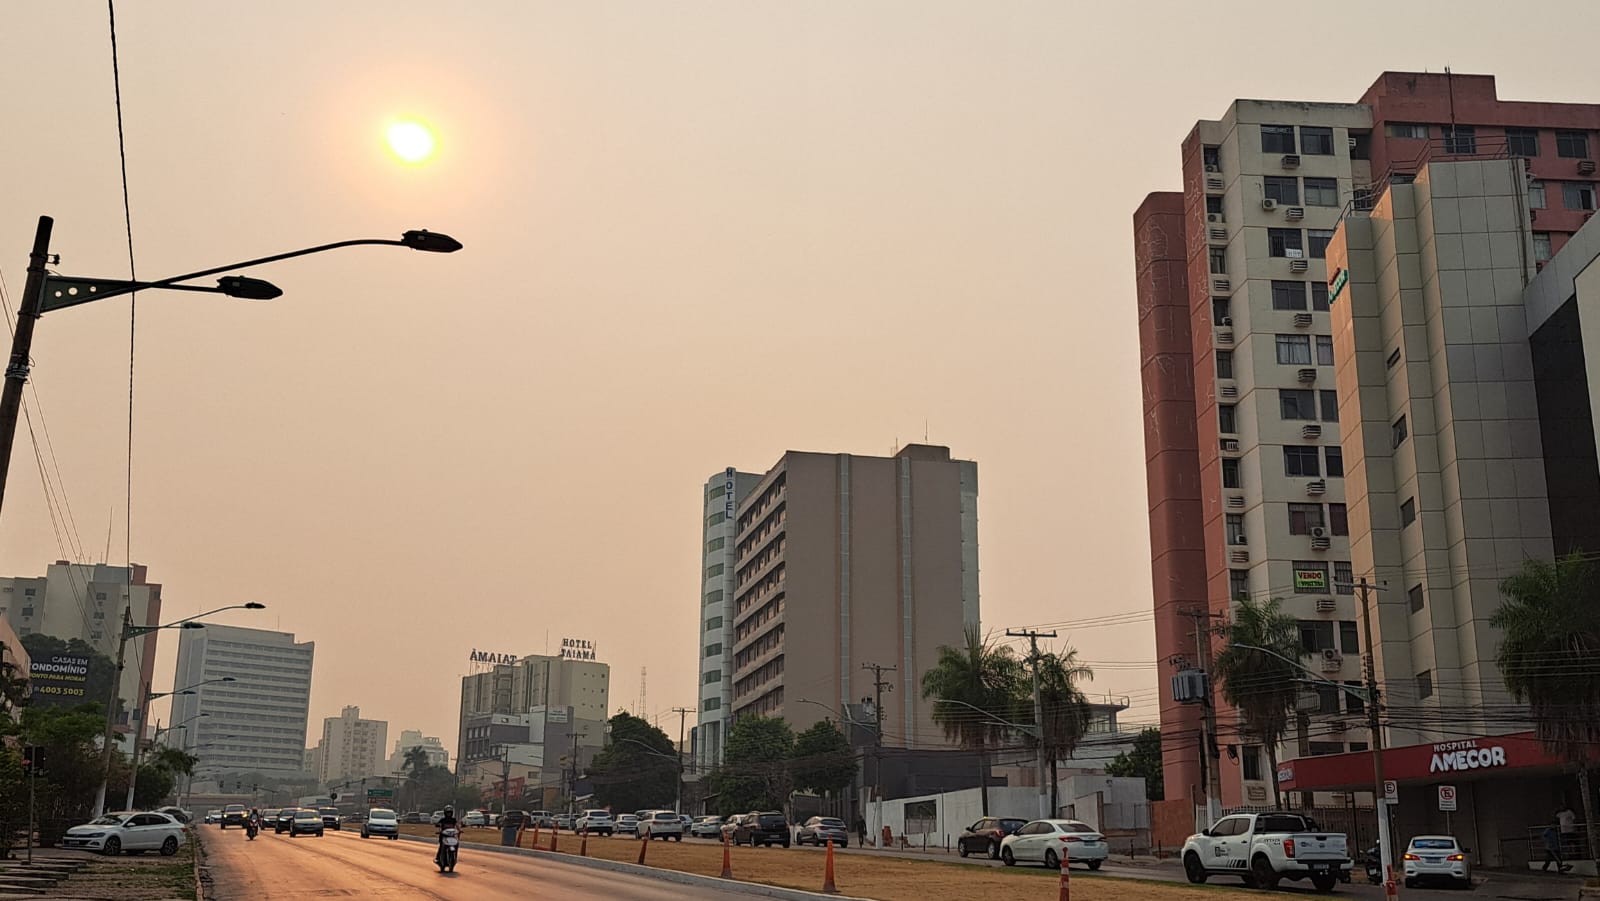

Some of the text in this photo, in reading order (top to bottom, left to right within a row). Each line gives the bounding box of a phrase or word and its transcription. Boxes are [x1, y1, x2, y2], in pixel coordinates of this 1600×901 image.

[725, 467, 734, 520] HOTEL
[562, 638, 592, 649] HOTEL
[51, 656, 88, 666] CASAS EM
[31, 662, 87, 674] ONDOMÍNIO
[40, 686, 84, 696] 4003 5003
[1433, 740, 1478, 752] HOSPITAL
[1430, 746, 1506, 773] AMECOR
